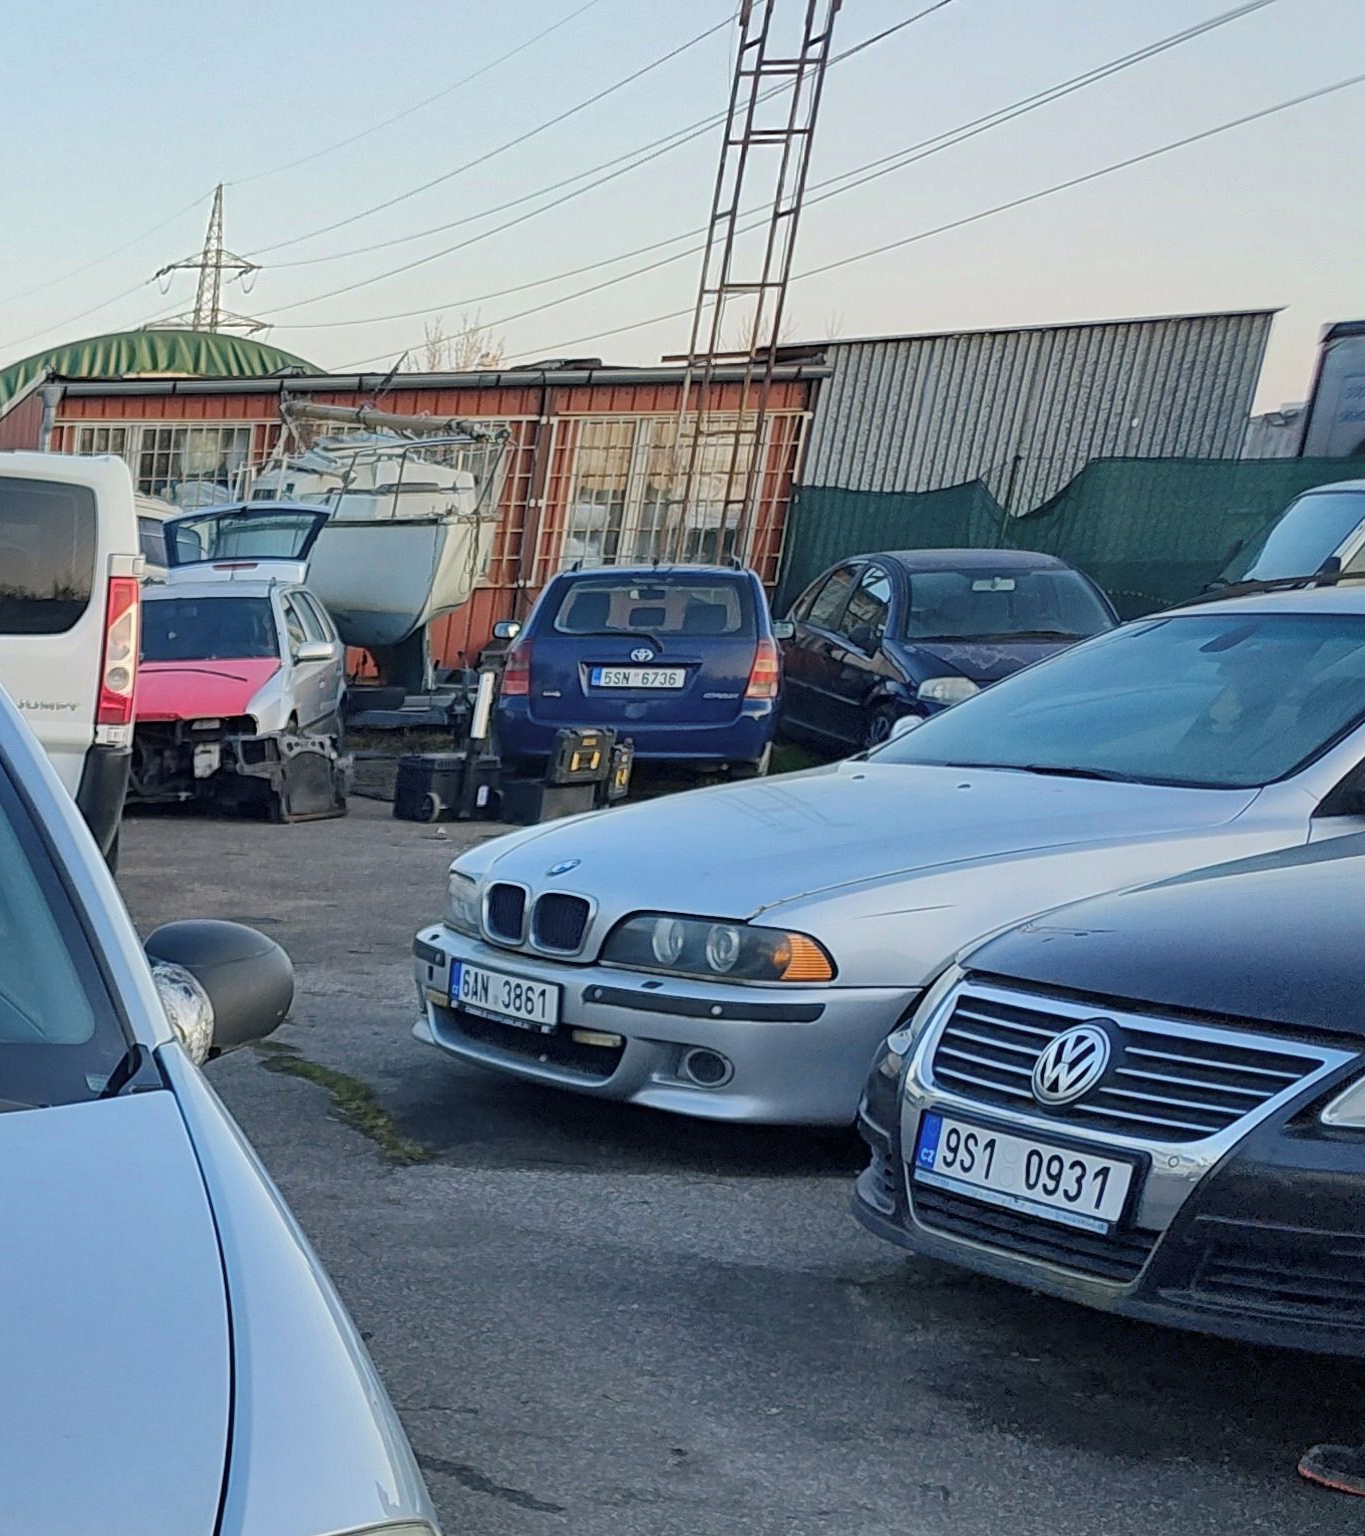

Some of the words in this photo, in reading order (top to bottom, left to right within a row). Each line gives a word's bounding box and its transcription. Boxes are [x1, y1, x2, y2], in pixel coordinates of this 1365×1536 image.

[604, 671, 630, 685] 5SN
[641, 672, 677, 686] 6736
[462, 969, 490, 1004] 6AN
[501, 980, 547, 1019] 3861
[920, 1147, 934, 1163] CZ
[942, 1127, 998, 1180] 9S1
[1024, 1148, 1111, 1210] 0931
